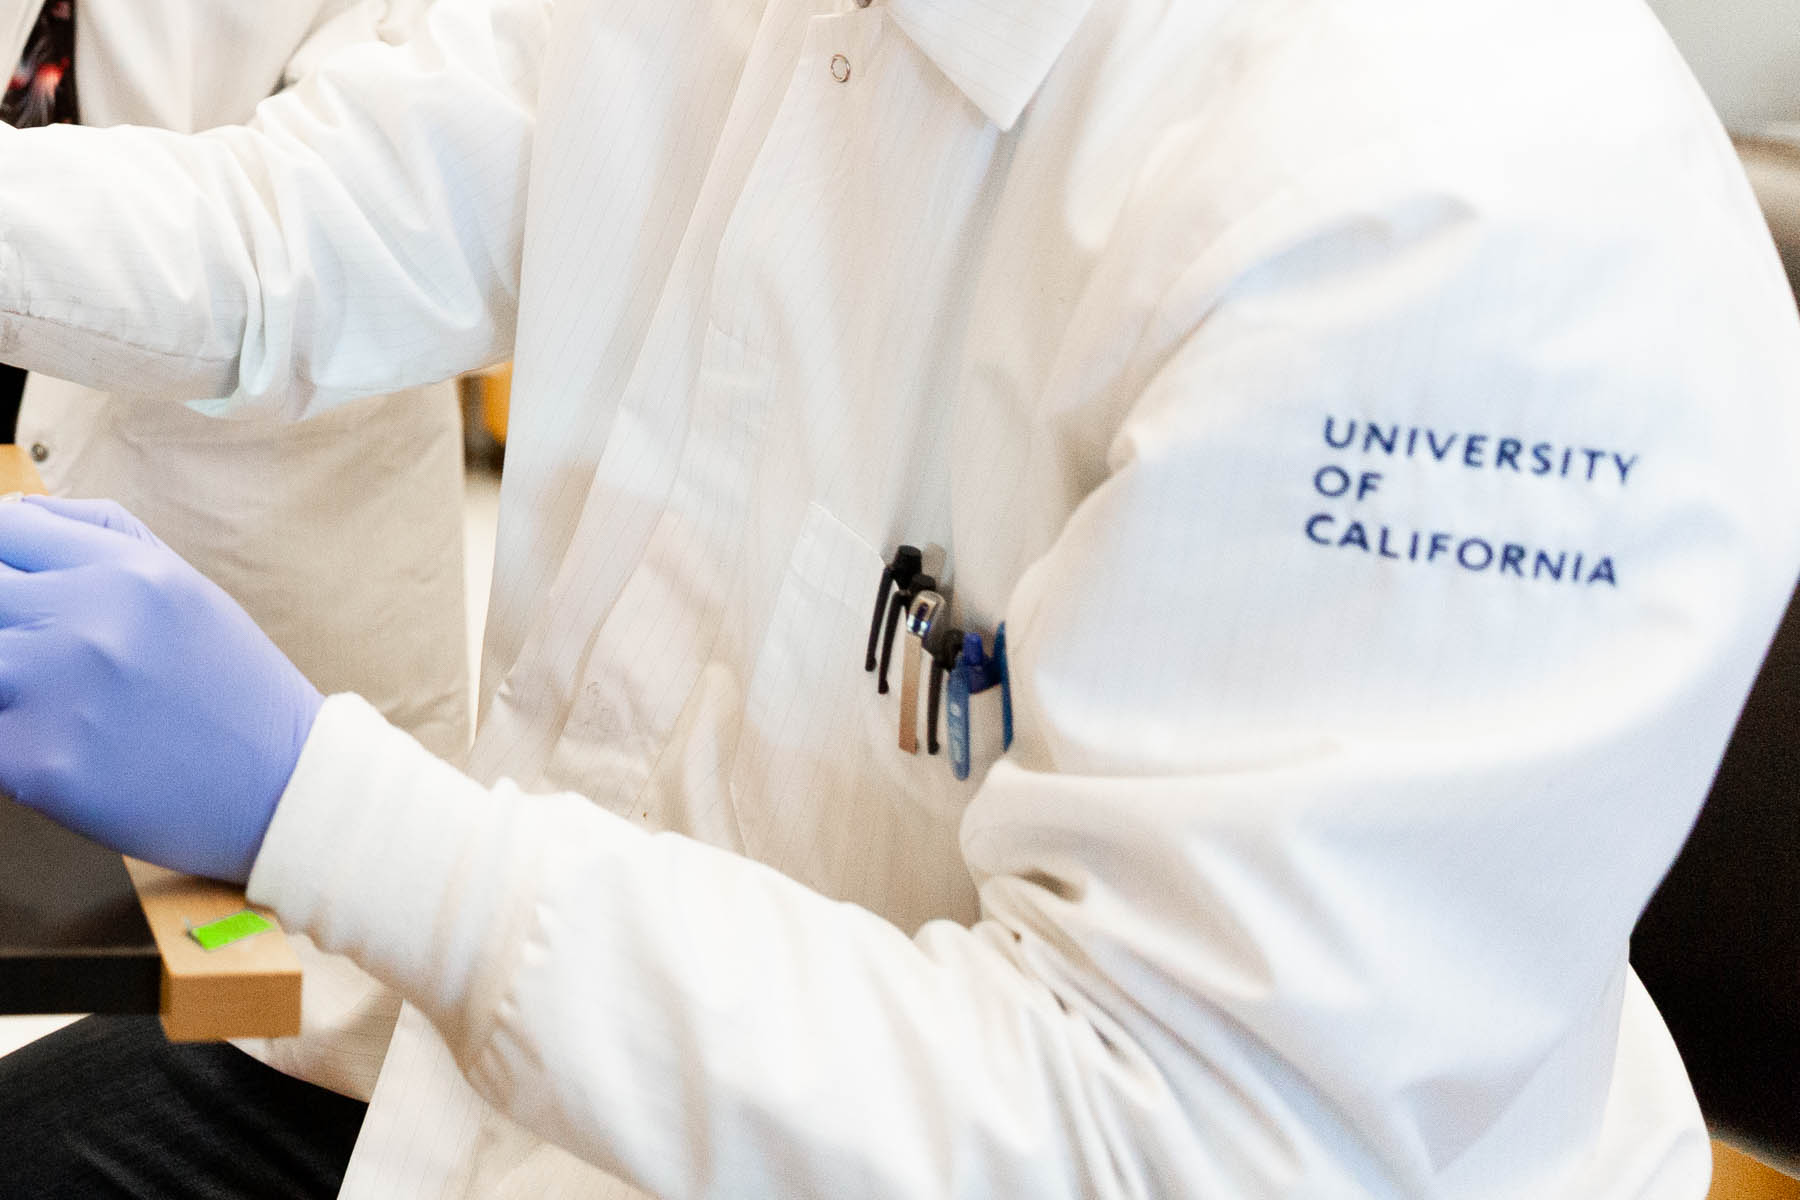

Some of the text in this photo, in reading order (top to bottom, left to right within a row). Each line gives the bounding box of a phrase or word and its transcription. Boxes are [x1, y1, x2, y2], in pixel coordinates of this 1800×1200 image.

[1313, 465, 1383, 502] OF
[1323, 415, 1639, 486] UNIVERSITY
[1304, 513, 1618, 587] CALIFORNIA
